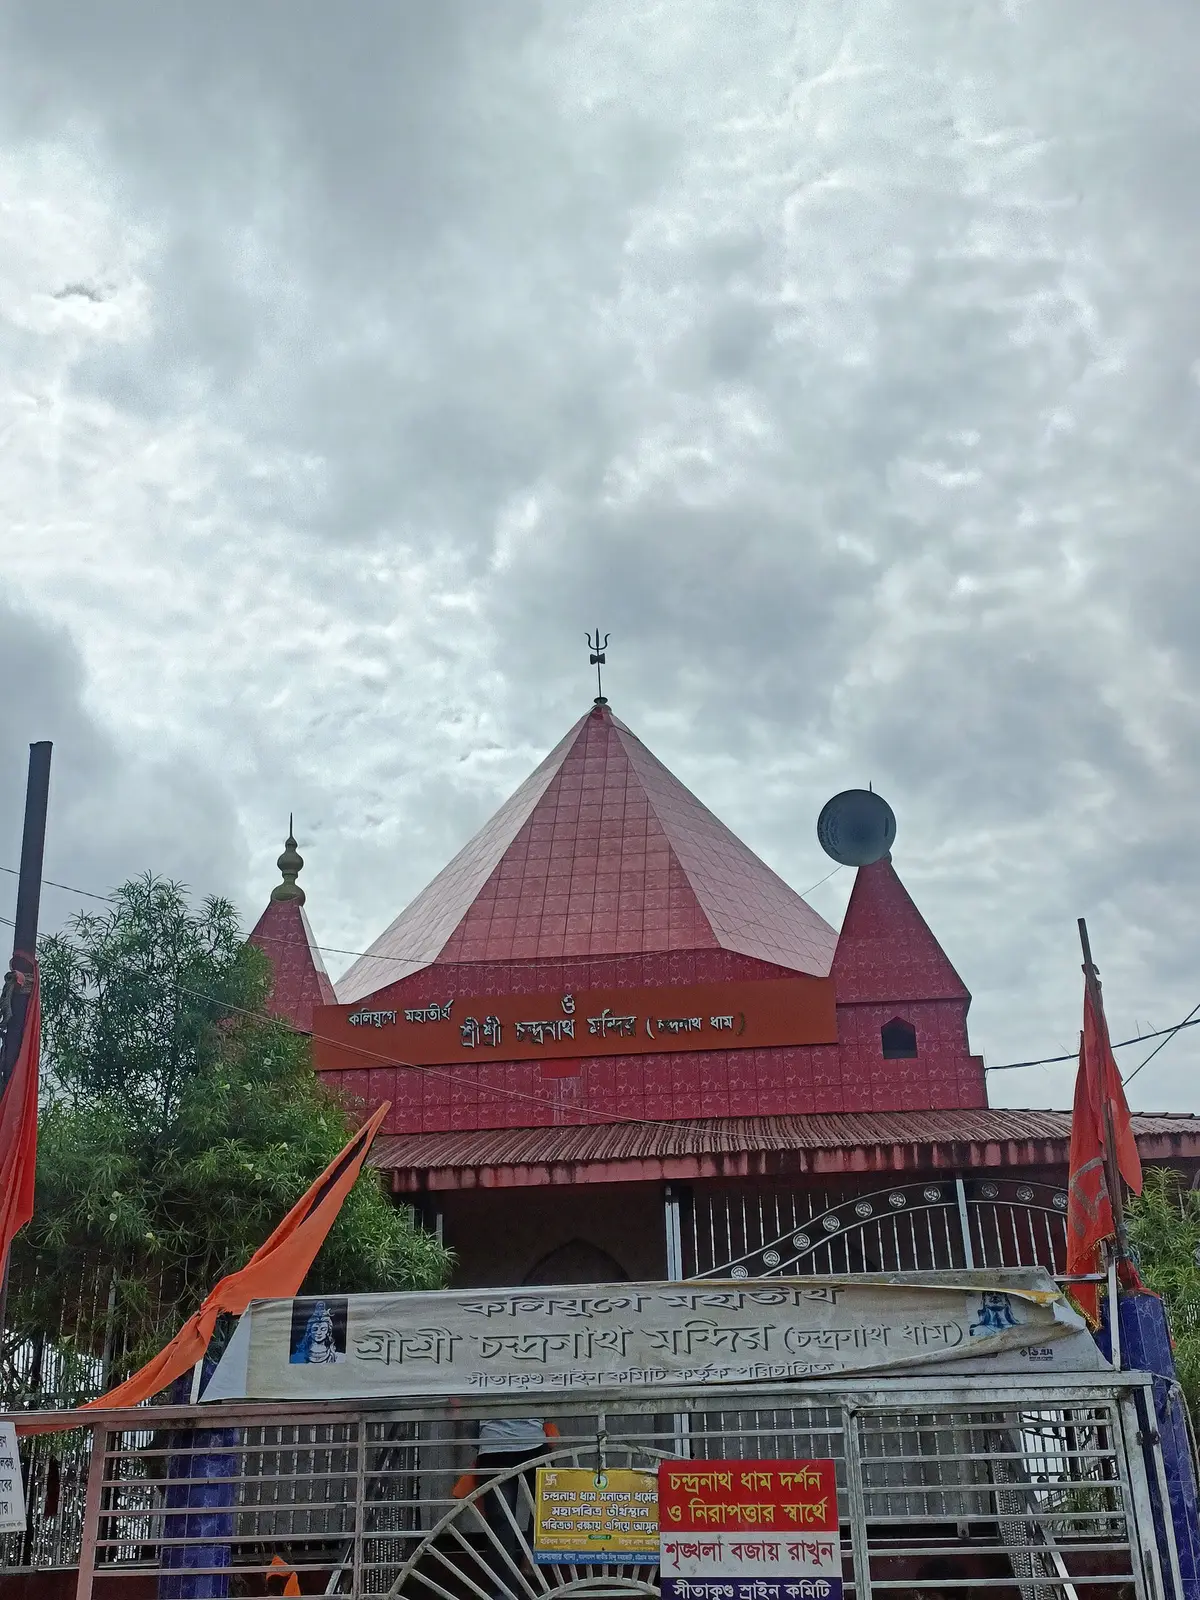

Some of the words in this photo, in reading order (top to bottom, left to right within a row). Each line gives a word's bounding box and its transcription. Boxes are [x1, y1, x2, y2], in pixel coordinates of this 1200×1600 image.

[347, 1007, 397, 1027] কলিযুগে
[404, 998, 455, 1024] মহাতীর্থ
[516, 1017, 576, 1044] চন্দ্রনাথ
[587, 1008, 637, 1039] মন্দির
[459, 1292, 651, 1319] কলিযুগে
[468, 1323, 634, 1363] চন্দ্রনাথ
[641, 1318, 777, 1356] মন্দির
[607, 1366, 670, 1385] কমিটি
[668, 1471, 733, 1494] চন্দ্রনাথ
[740, 1472, 773, 1492] ধাম
[779, 1465, 823, 1491] দর্শন
[542, 1491, 576, 1502] চন্দ্রনাথ
[580, 1491, 597, 1502] ধাম
[600, 1491, 631, 1502] সনাতন
[634, 1489, 658, 1504] ধর্মের
[667, 1506, 682, 1521] ও
[688, 1498, 776, 1524] নিরাপত্তার
[782, 1497, 828, 1524] স্বার্থে
[604, 1519, 630, 1532] এগিয়ে
[633, 1521, 658, 1534] আসুন
[663, 1540, 725, 1570] শৃঙ্খলা
[728, 1541, 782, 1563] বজায়
[787, 1540, 836, 1567] রাখুন
[672, 1580, 735, 1600] সীতাকুণ্ড
[783, 1578, 832, 1598] কমিটি
